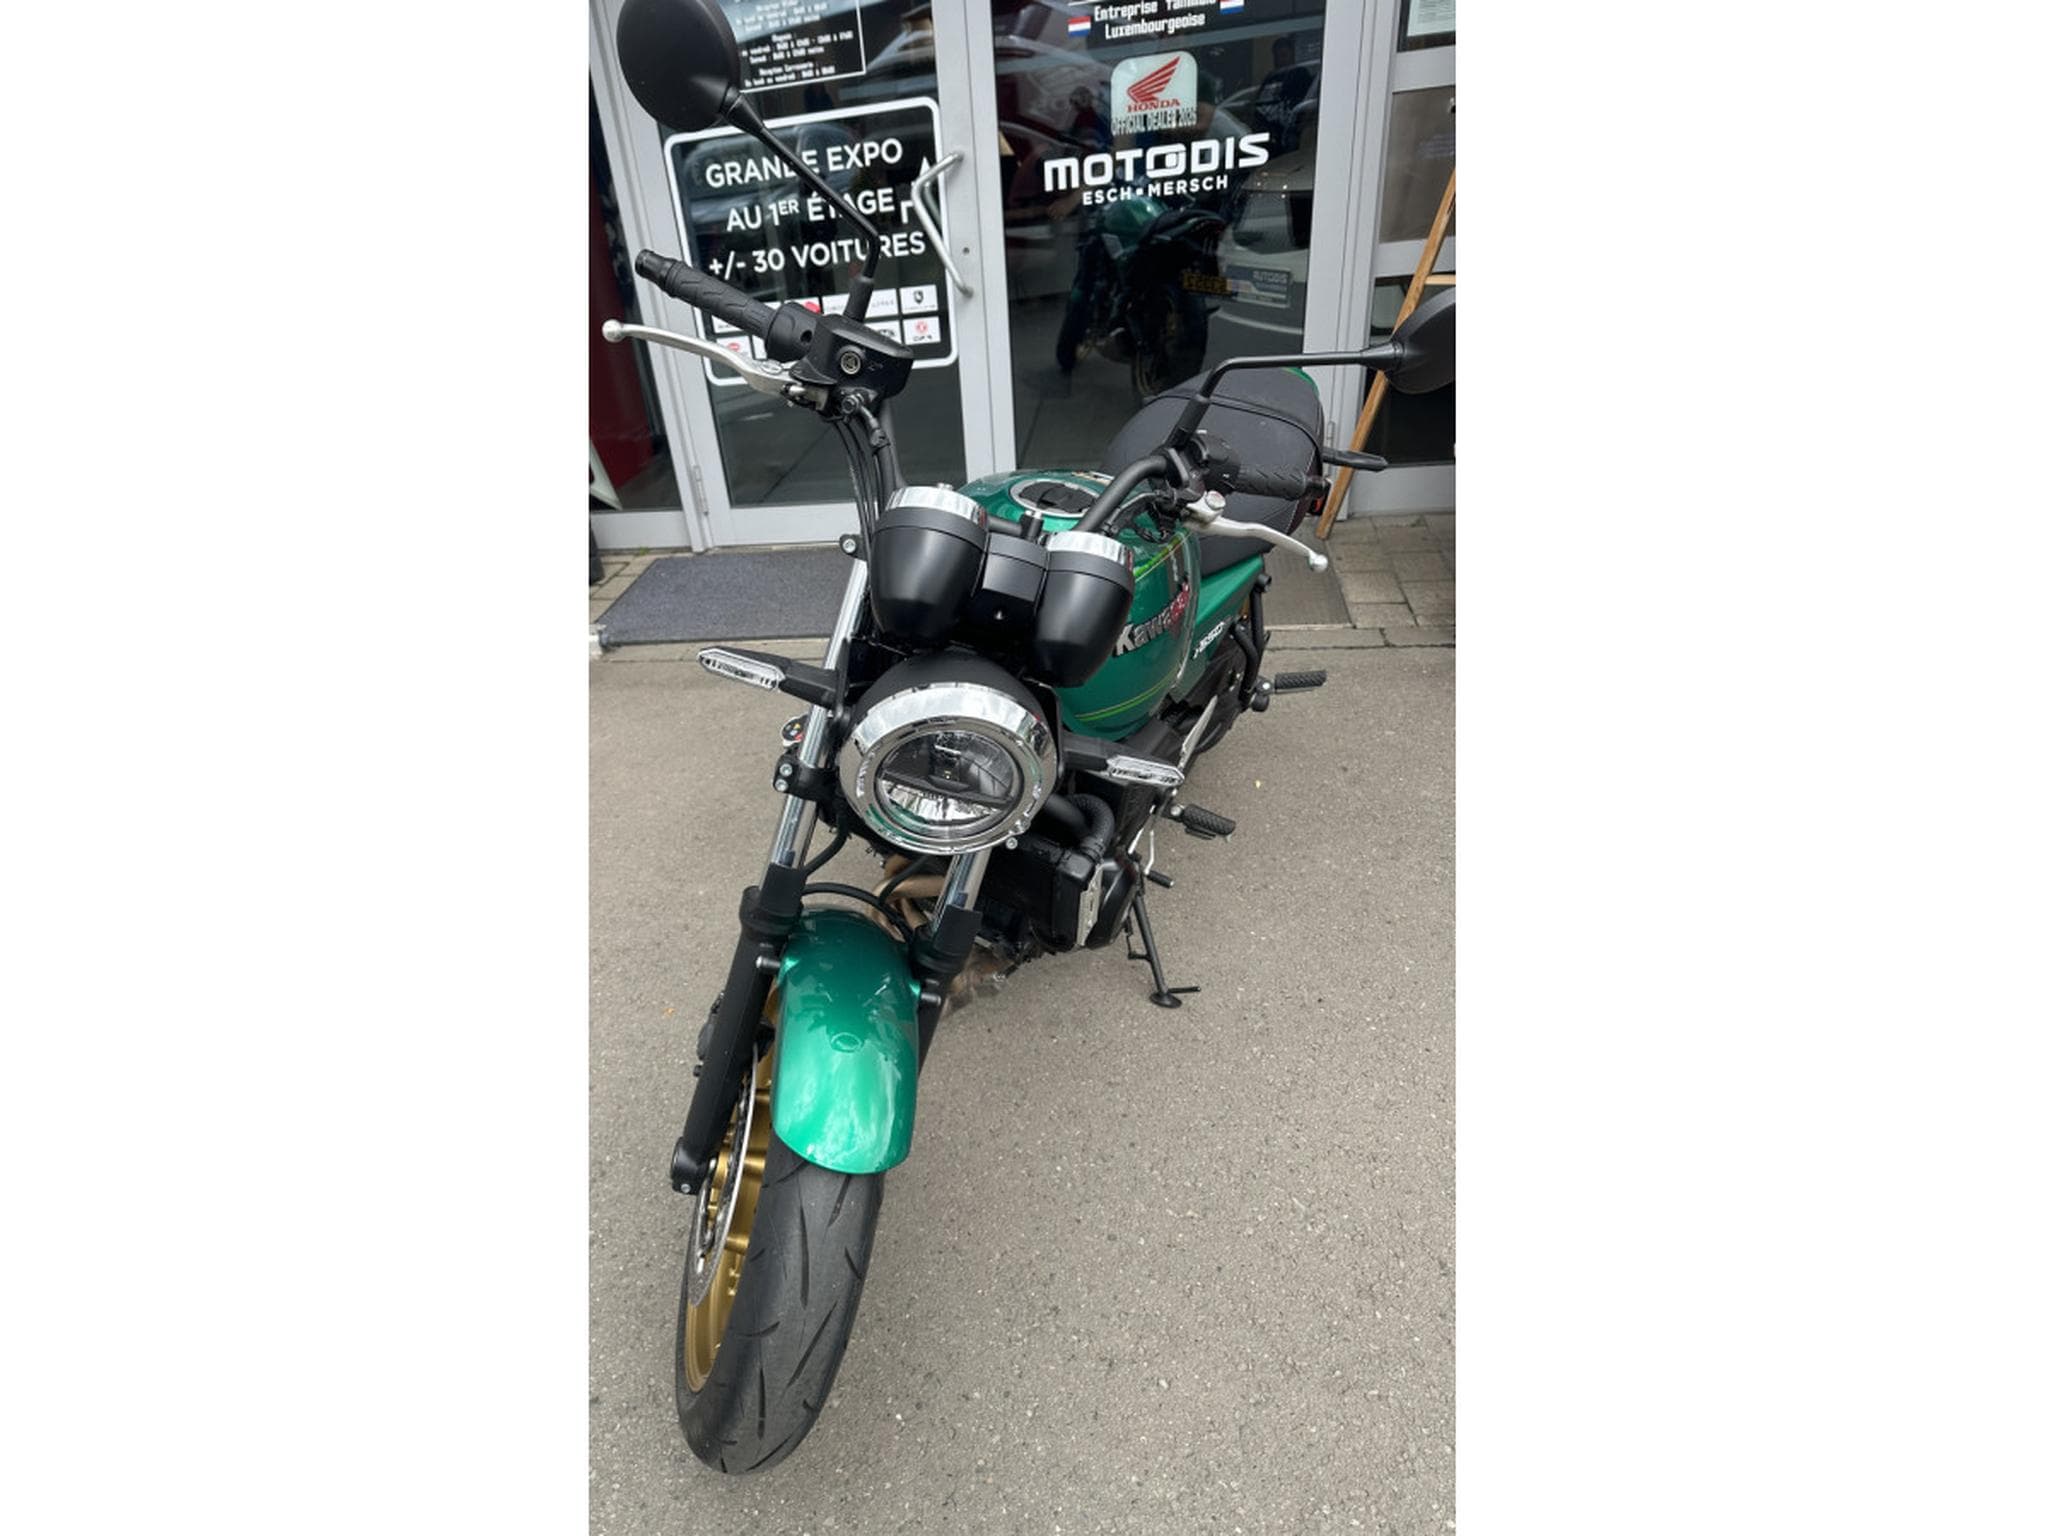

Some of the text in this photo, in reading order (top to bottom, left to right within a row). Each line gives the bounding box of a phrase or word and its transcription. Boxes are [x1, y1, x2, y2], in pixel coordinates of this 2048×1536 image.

[1094, 1, 1158, 21] Entreprise
[1105, 13, 1206, 39] Luxembourgeoise
[1126, 98, 1181, 113] HONDA
[826, 138, 903, 172] EXPO
[1043, 132, 1271, 191] MOTODIS
[726, 208, 762, 232] AU
[768, 199, 800, 226] 1ER
[753, 249, 785, 273] 30
[791, 231, 926, 268] VOITURES
